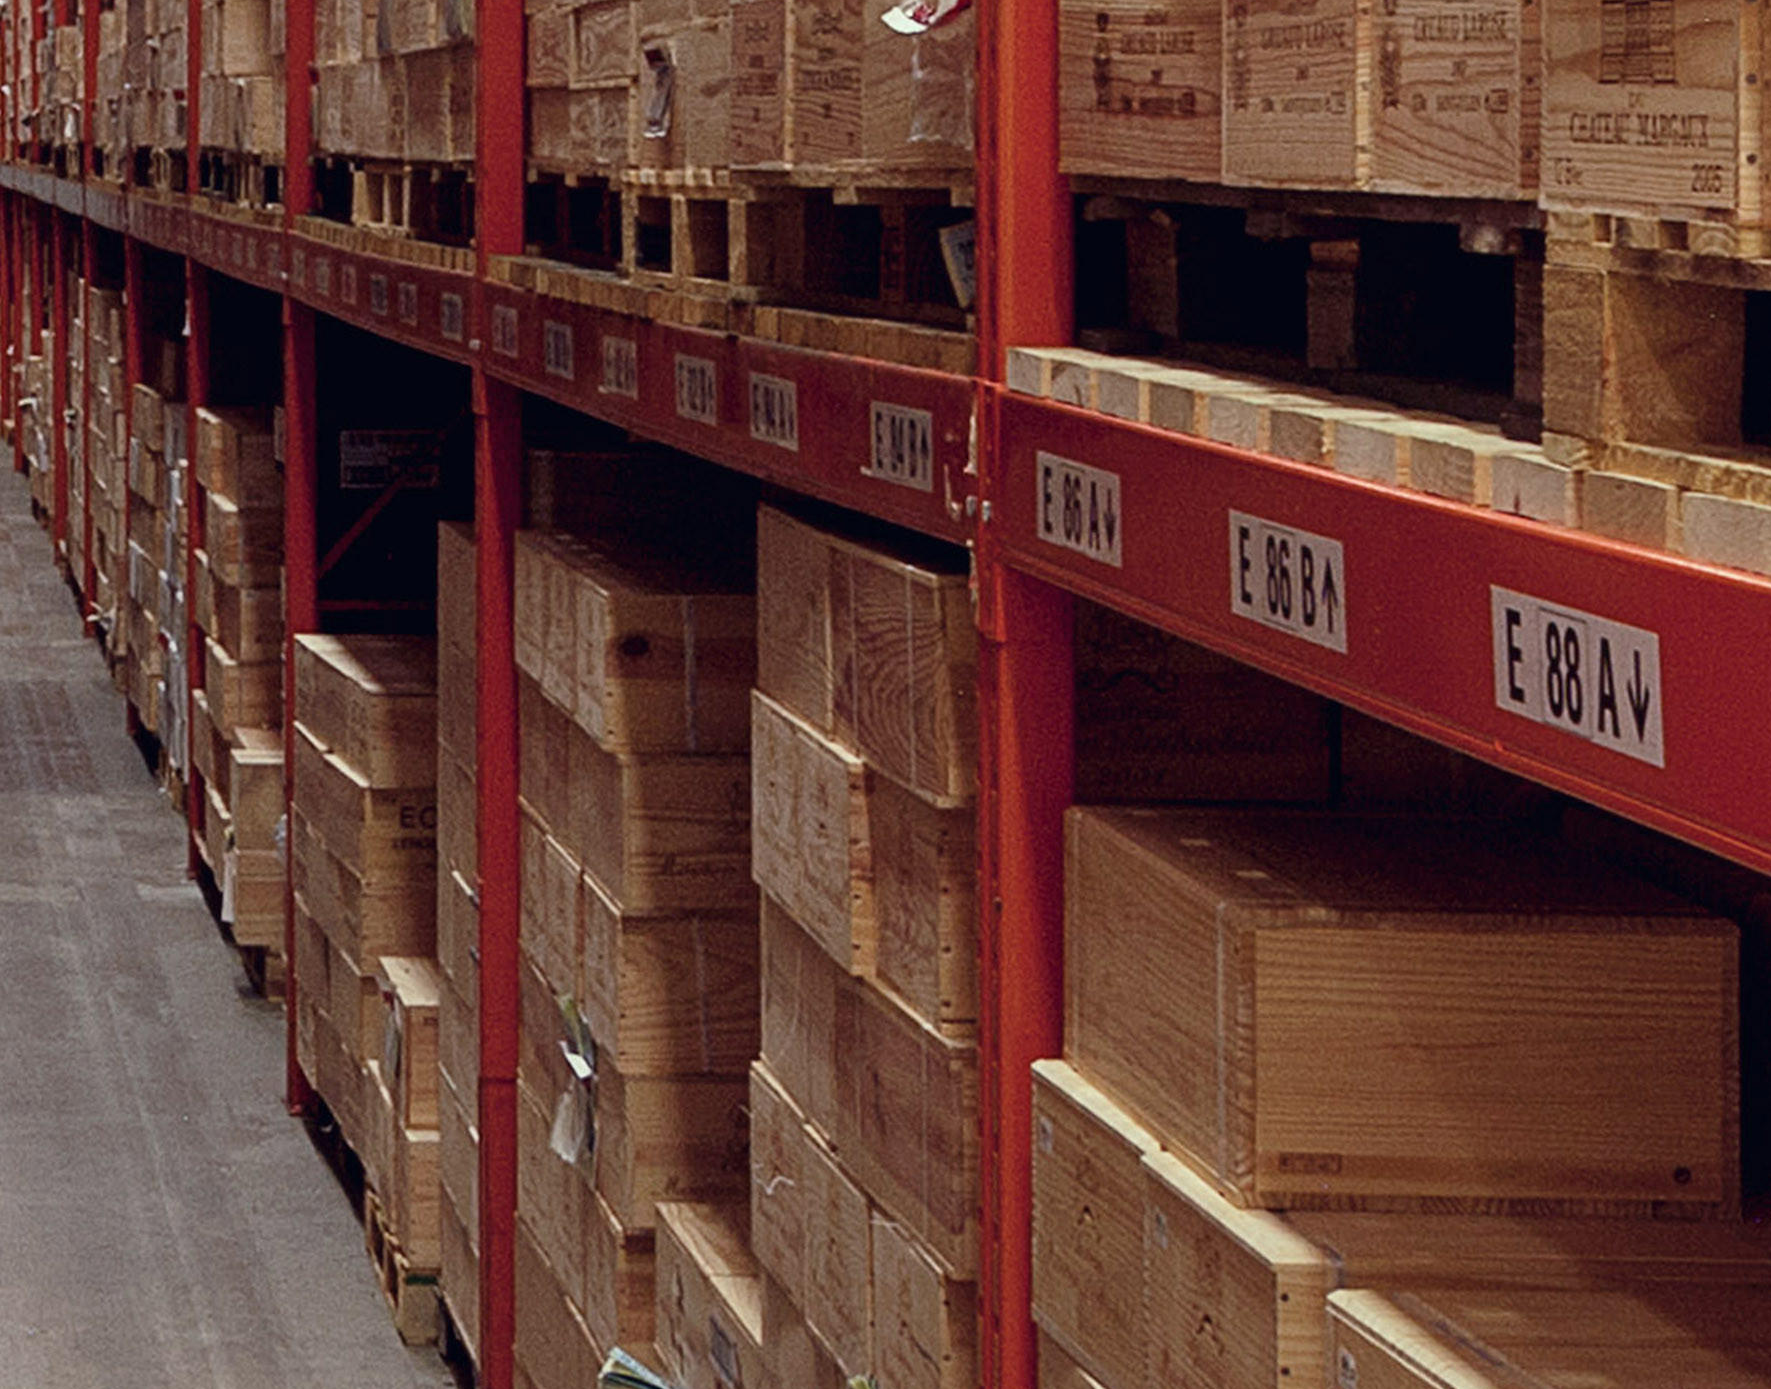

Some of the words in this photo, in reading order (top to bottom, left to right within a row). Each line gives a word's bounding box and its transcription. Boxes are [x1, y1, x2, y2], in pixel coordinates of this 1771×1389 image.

[1041, 465, 1054, 534] E
[1063, 469, 1083, 544] 86
[1086, 481, 1101, 553] A
[1239, 524, 1253, 606] E
[1265, 531, 1293, 622] 86
[1300, 543, 1317, 627] B
[1505, 607, 1526, 705] E
[1545, 620, 1583, 726] 88
[1597, 637, 1621, 740] A
